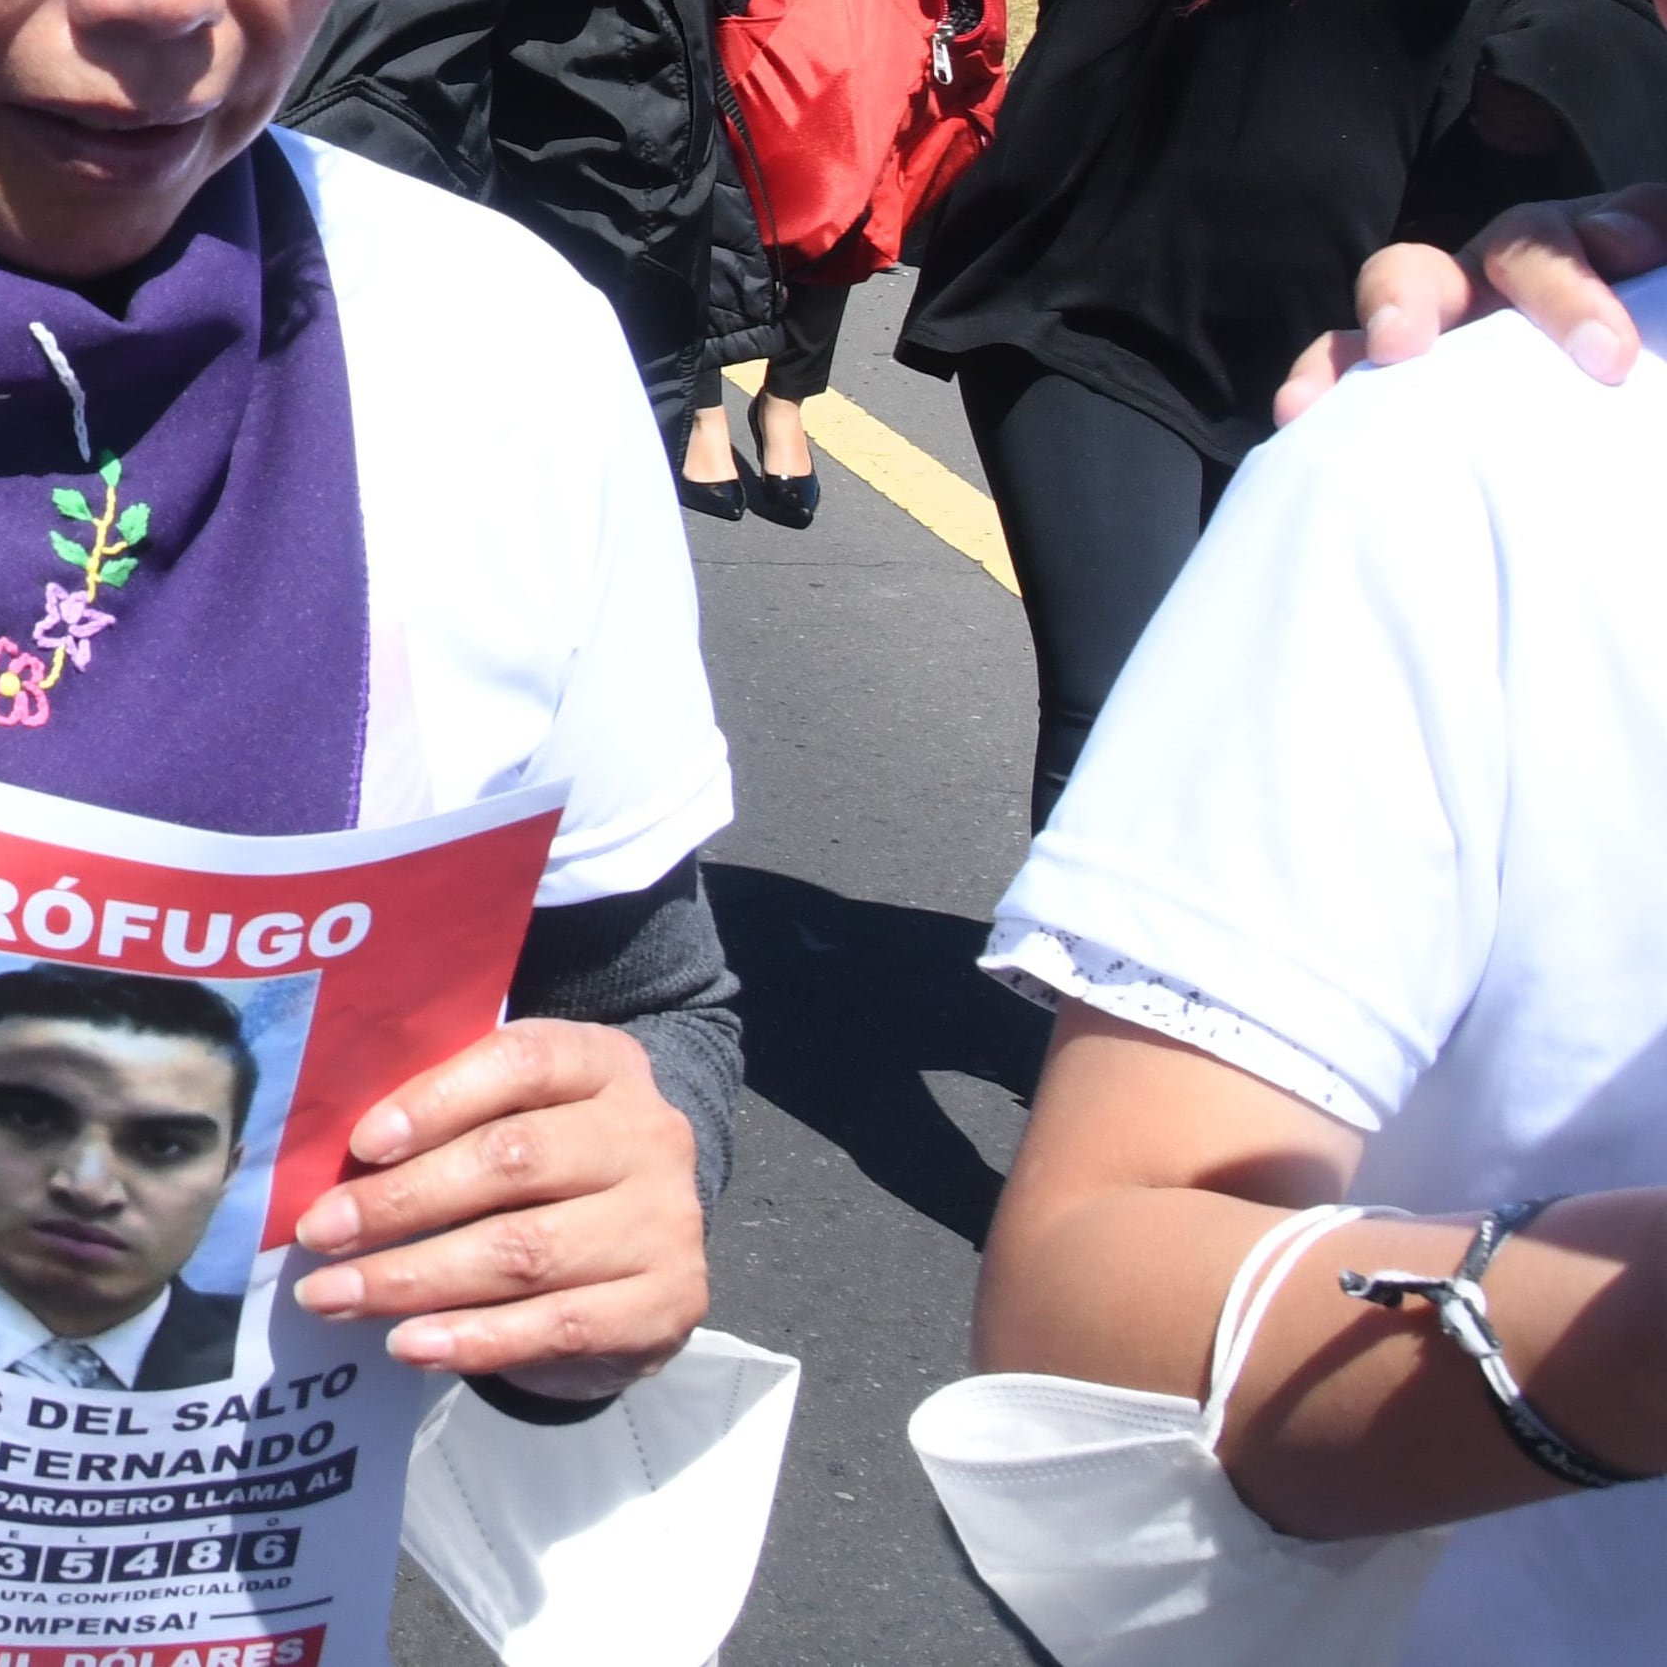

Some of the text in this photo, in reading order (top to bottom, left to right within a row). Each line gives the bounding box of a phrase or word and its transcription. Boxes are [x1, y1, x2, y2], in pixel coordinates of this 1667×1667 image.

[26, 1396, 150, 1436] DEL
[171, 1362, 359, 1433] SALTO
[183, 1479, 298, 1512] LLAMA
[305, 1465, 343, 1490] AL
[56, 1576, 292, 1606] CONFIDENCIALIDAD
